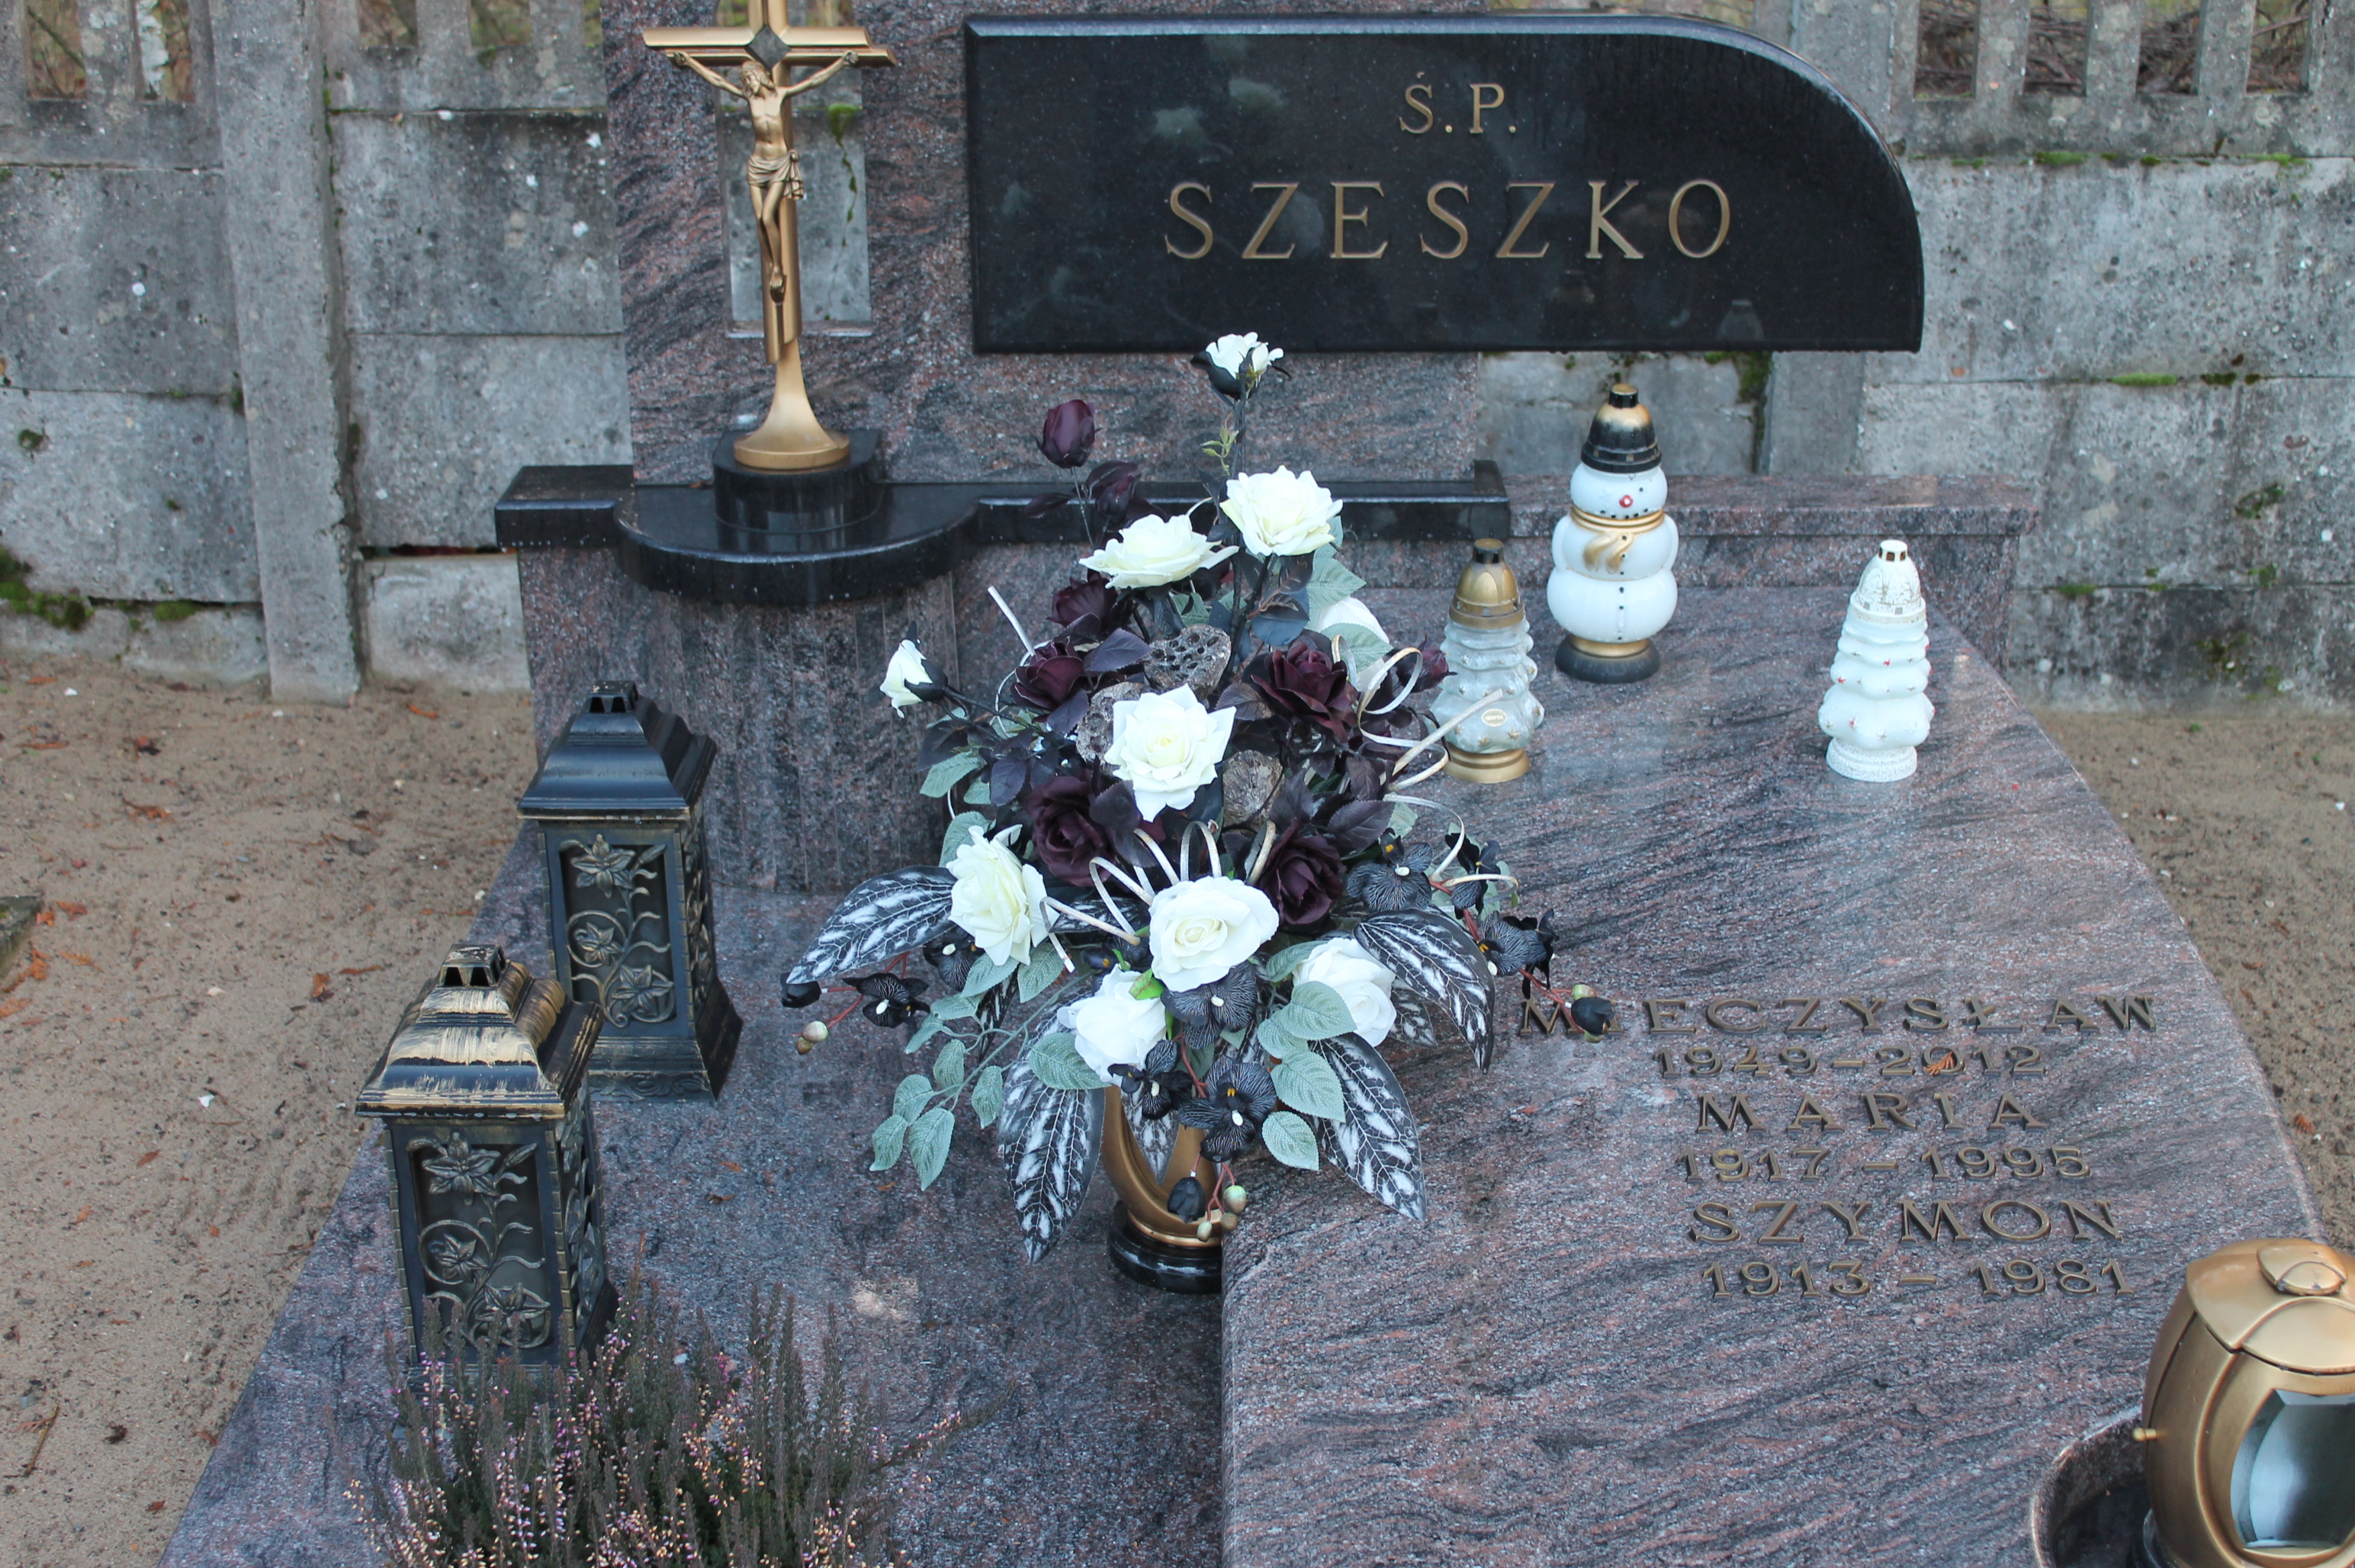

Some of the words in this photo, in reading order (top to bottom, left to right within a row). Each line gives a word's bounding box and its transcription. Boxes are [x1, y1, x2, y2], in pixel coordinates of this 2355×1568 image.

[1165, 178, 1730, 261] SZESZKO
[1696, 1092, 2045, 1133] MARIA
[1690, 1200, 2122, 1245] SZYMON
